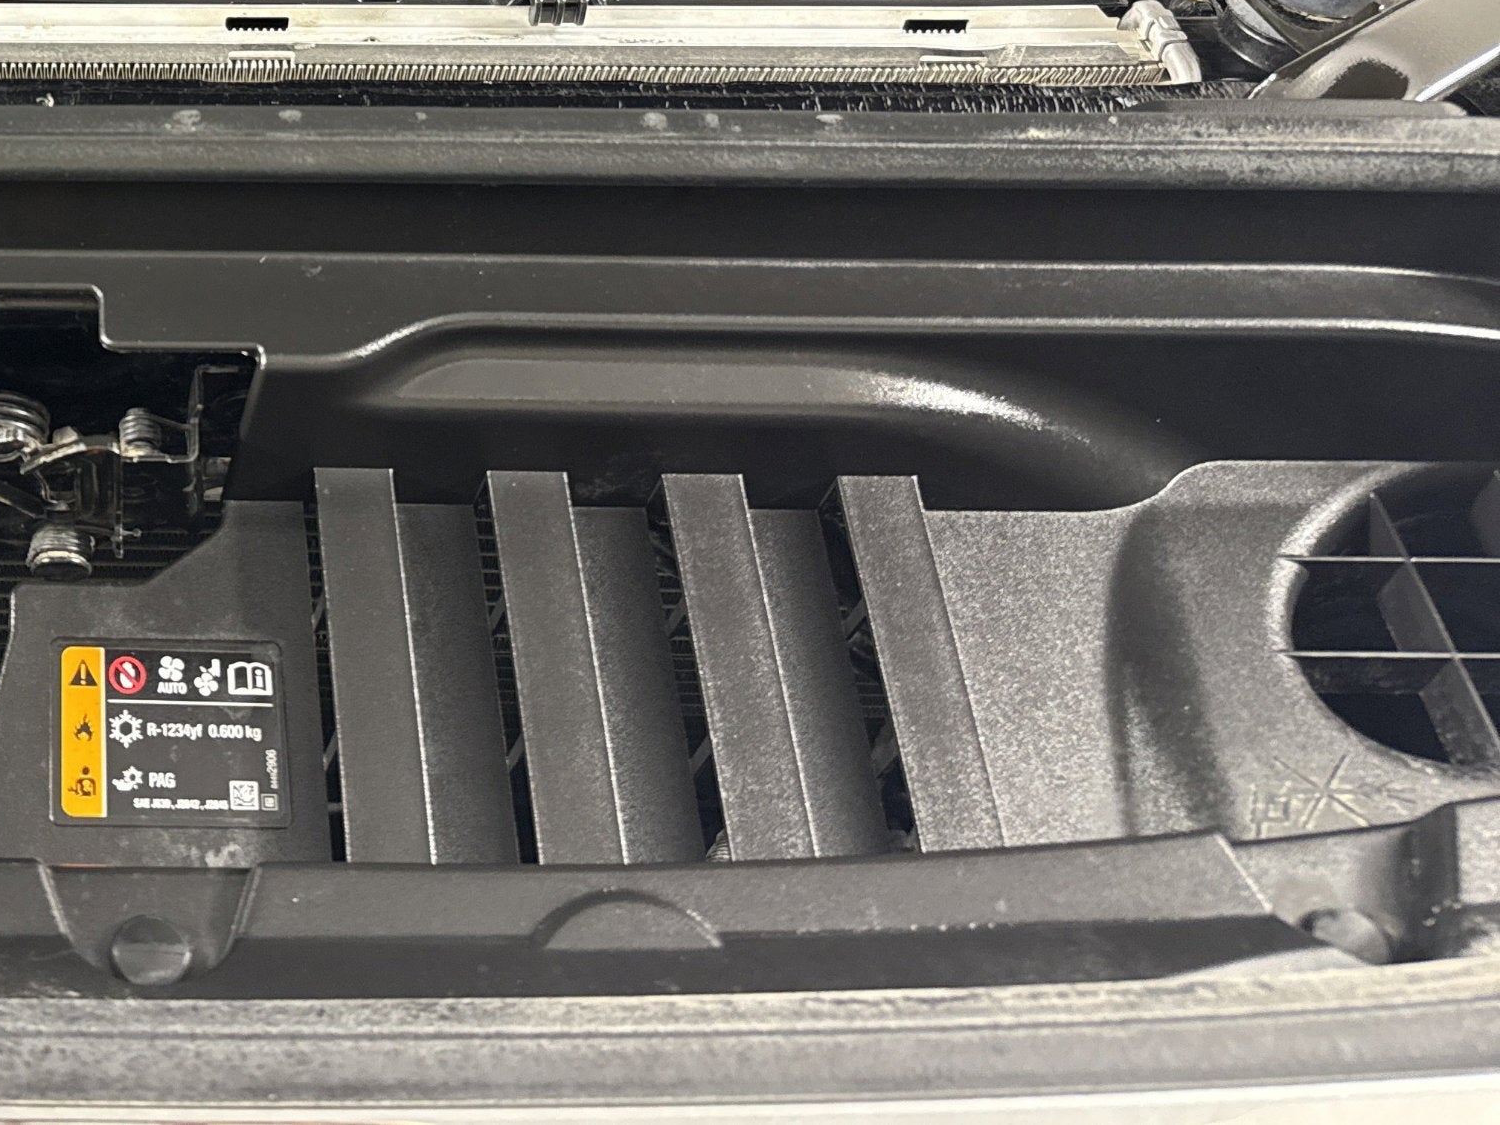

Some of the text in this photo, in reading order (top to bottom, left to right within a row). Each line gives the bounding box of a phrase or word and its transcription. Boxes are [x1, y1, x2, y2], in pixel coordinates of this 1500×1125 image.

[157, 681, 188, 695] AUTO
[146, 722, 262, 742] R-1234yf 0.600 kg
[148, 772, 177, 788] PAG
